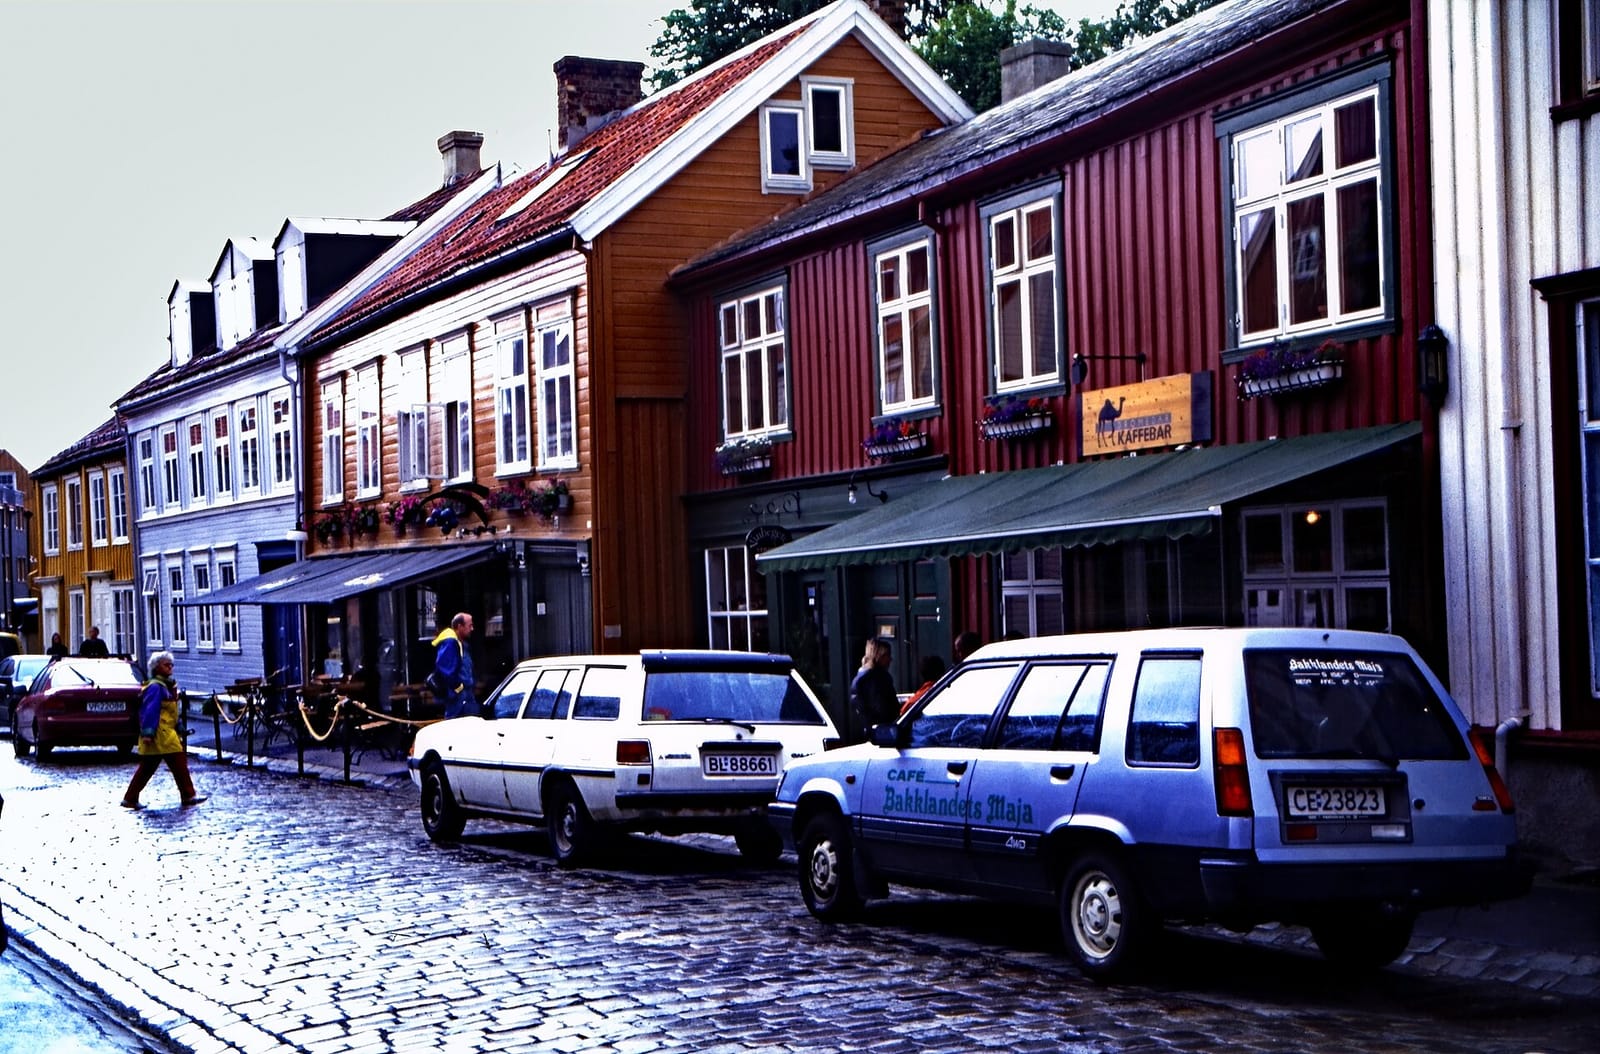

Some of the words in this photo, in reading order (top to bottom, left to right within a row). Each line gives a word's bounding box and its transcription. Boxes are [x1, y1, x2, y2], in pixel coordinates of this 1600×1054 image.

[1118, 426, 1171, 445] KAFFEBAR
[887, 768, 925, 782] CAFÉ
[883, 785, 982, 819] Bakklandets
[986, 794, 1033, 828] Maja
[1005, 836, 1026, 849] 4WD
